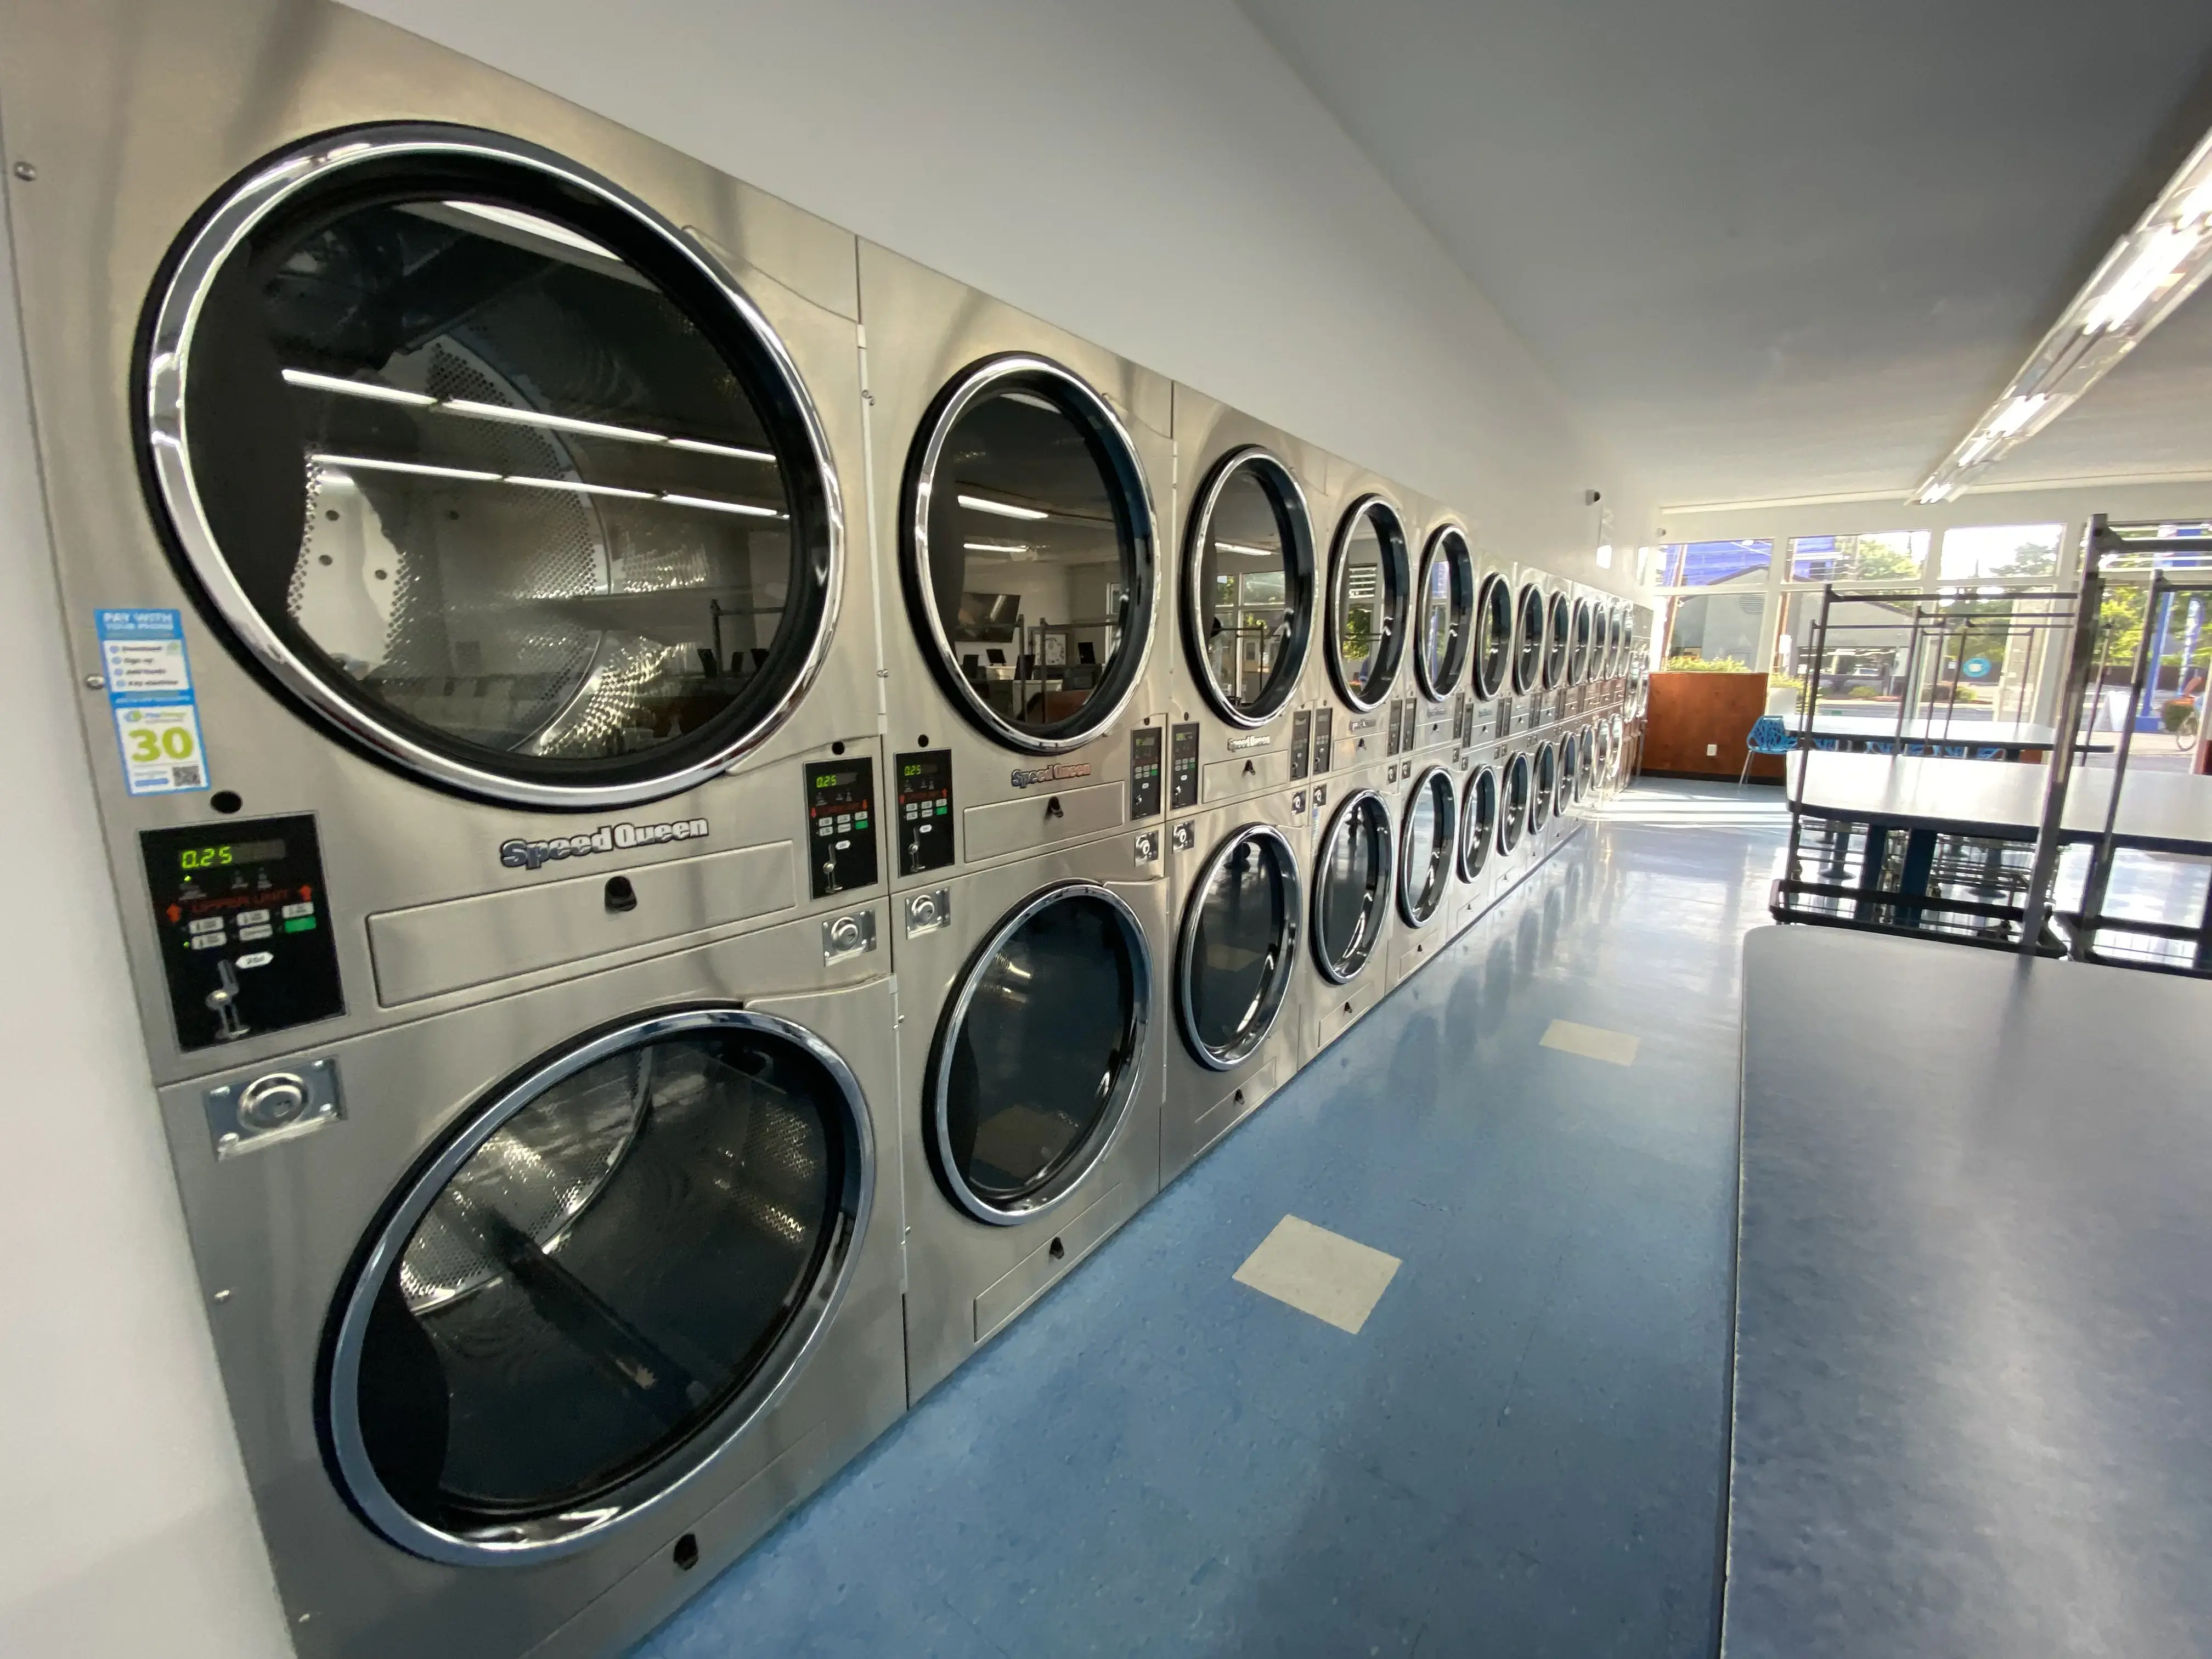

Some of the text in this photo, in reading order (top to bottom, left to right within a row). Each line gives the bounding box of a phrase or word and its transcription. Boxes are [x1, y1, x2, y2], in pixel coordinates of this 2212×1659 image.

[128, 727, 194, 762] 30
[1011, 763, 1091, 788] Speed Queen
[181, 846, 233, 869] 0.25
[500, 818, 709, 870] Speed Queen
